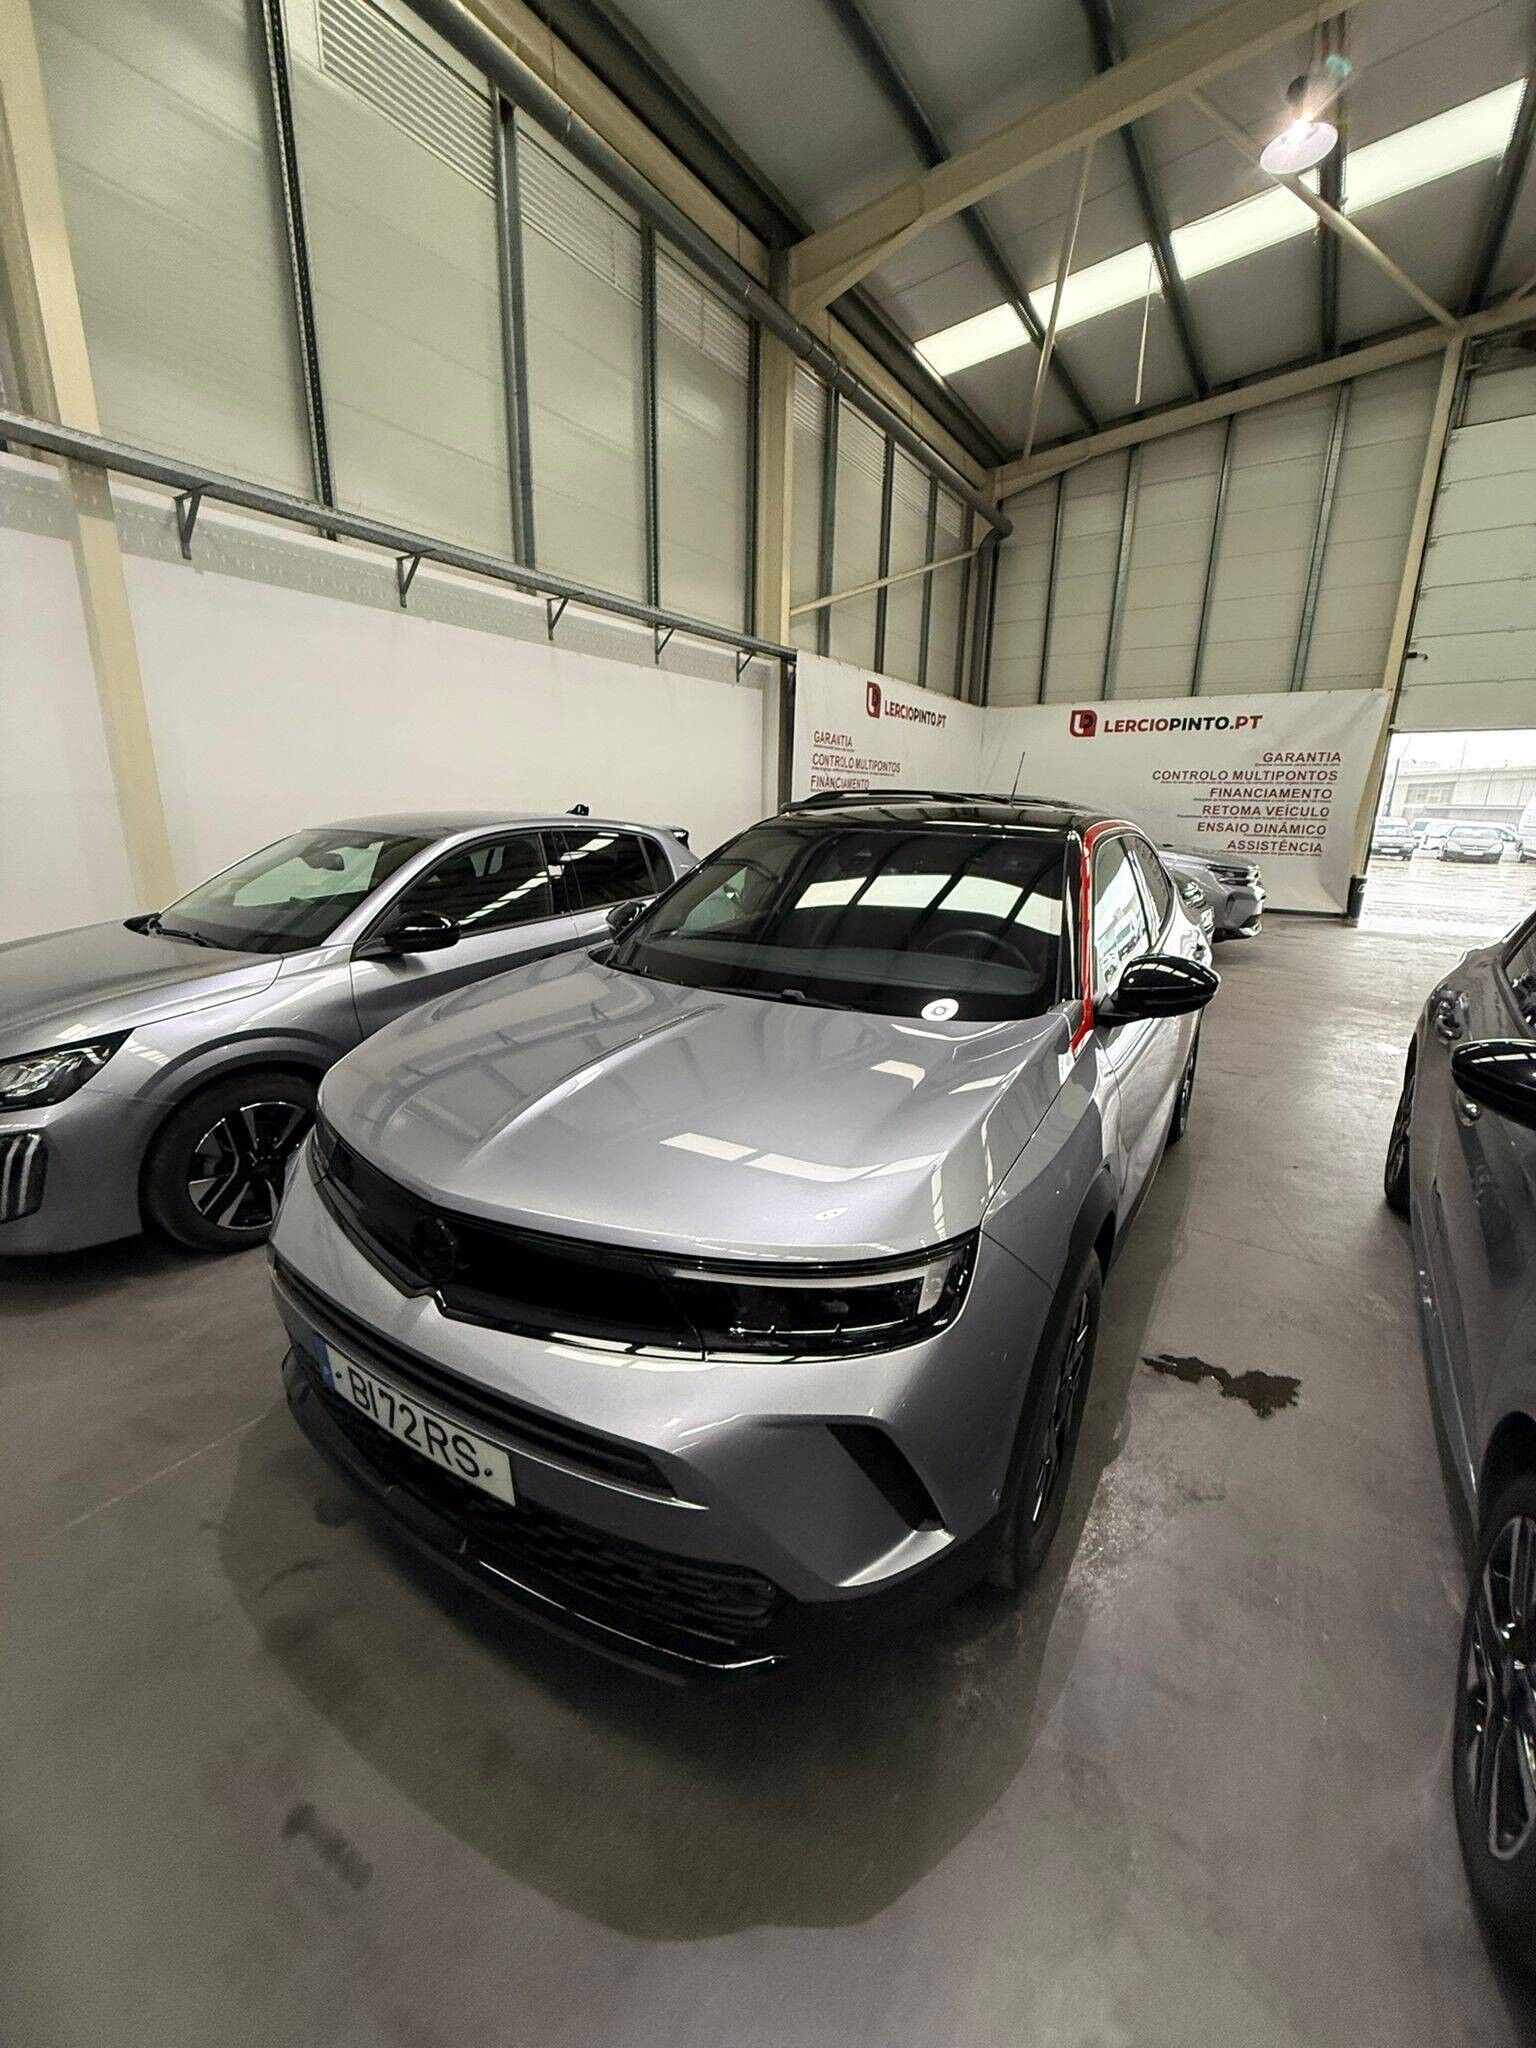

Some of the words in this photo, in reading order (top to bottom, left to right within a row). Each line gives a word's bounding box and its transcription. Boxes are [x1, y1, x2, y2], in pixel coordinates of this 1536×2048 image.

[884, 700, 947, 729] LERCIOPINTO.PT
[1103, 715, 1264, 733] LERCIOPINTO.PT
[813, 730, 853, 748] GARANTIA
[811, 753, 855, 770] CONTROLO
[855, 757, 901, 774] MULTIPONTOS
[1262, 751, 1342, 763] GARANTIA
[810, 775, 870, 791] FINANCIAMENTO
[1152, 770, 1229, 781] CONTROLO
[1232, 770, 1338, 781] MULTIPONTOS
[1209, 787, 1333, 800] FINANCIAMENTO
[1202, 804, 1261, 816] RETOMA
[1266, 804, 1330, 818] VEÍCULO
[1196, 821, 1250, 833] ENSAIO
[1253, 821, 1327, 836] DINÂMICO
[1226, 839, 1323, 854] ASSISTÊNCIA
